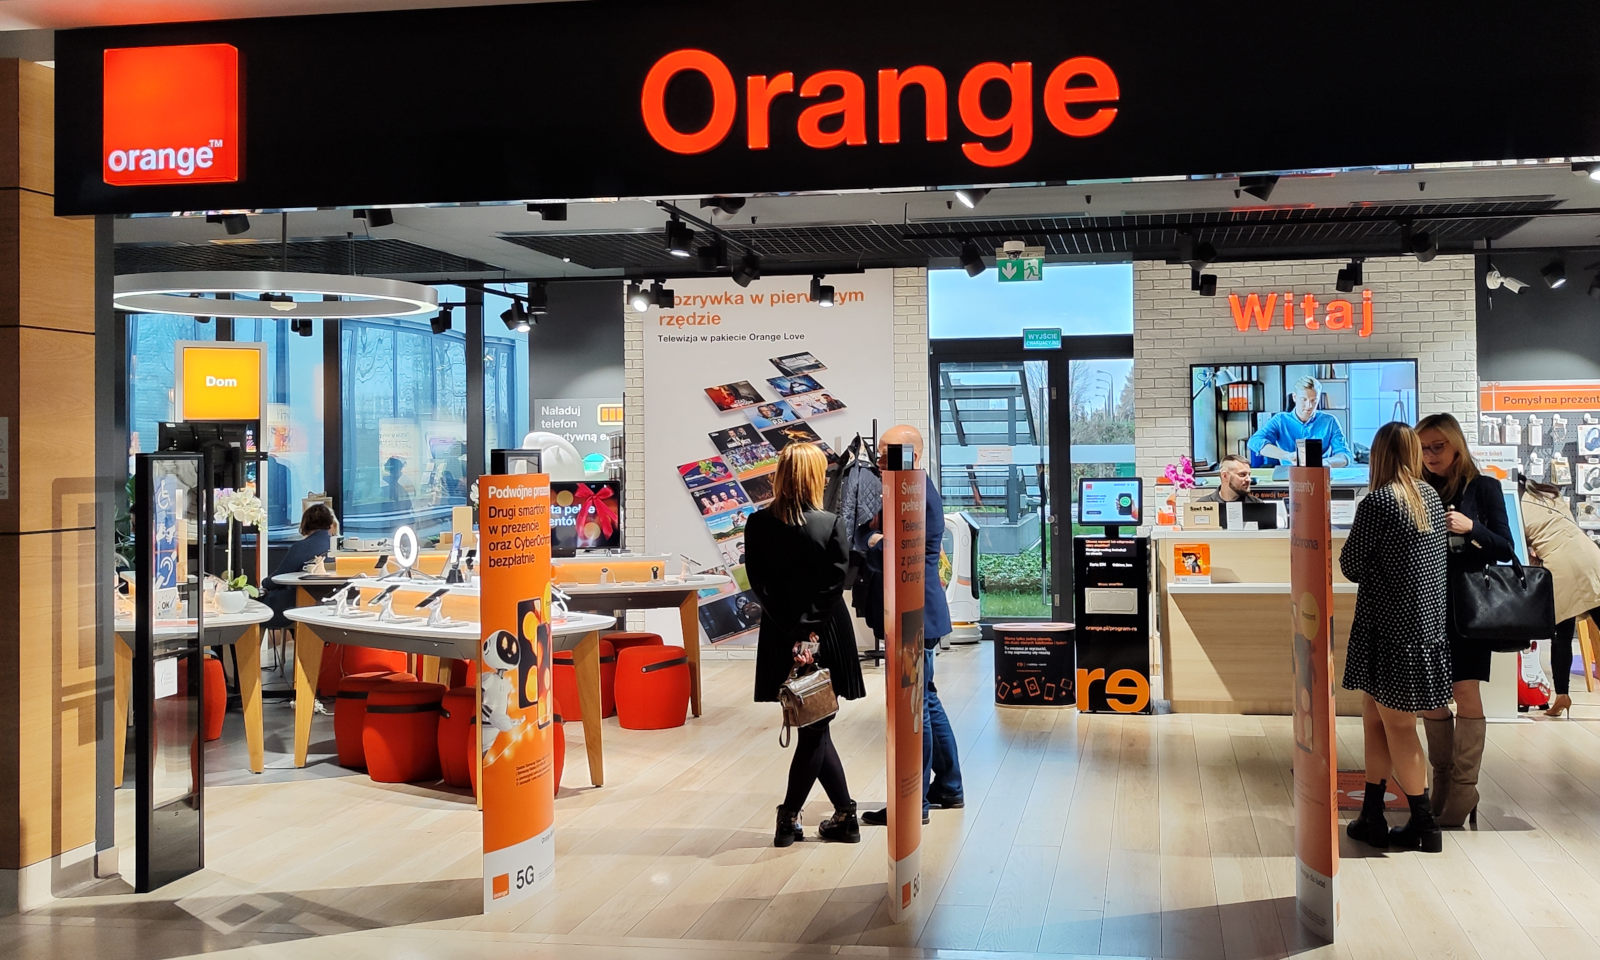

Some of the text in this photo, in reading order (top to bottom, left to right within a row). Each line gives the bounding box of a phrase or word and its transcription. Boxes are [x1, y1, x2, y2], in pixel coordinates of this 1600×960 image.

[640, 48, 1120, 168] Orange
[108, 146, 214, 176] orange
[673, 291, 745, 309] ozrywka
[750, 294, 765, 304] w
[659, 312, 721, 329] rzędzie
[1228, 288, 1373, 337] Witaj
[658, 334, 698, 343] Telewizja
[710, 334, 747, 343] pakiecie
[749, 333, 782, 342] Orange
[784, 332, 805, 341] Love
[205, 375, 238, 388] Dom
[1503, 395, 1542, 406] Pomysł
[541, 405, 580, 417] Naładuj
[541, 419, 577, 428] telefon
[488, 484, 533, 500] Podwójne
[489, 504, 516, 520] Drugi
[564, 503, 596, 516] pełe
[489, 525, 499, 535] w
[489, 541, 512, 552] oraz
[489, 552, 536, 568] bezpłatnie
[516, 865, 534, 890] 5G
